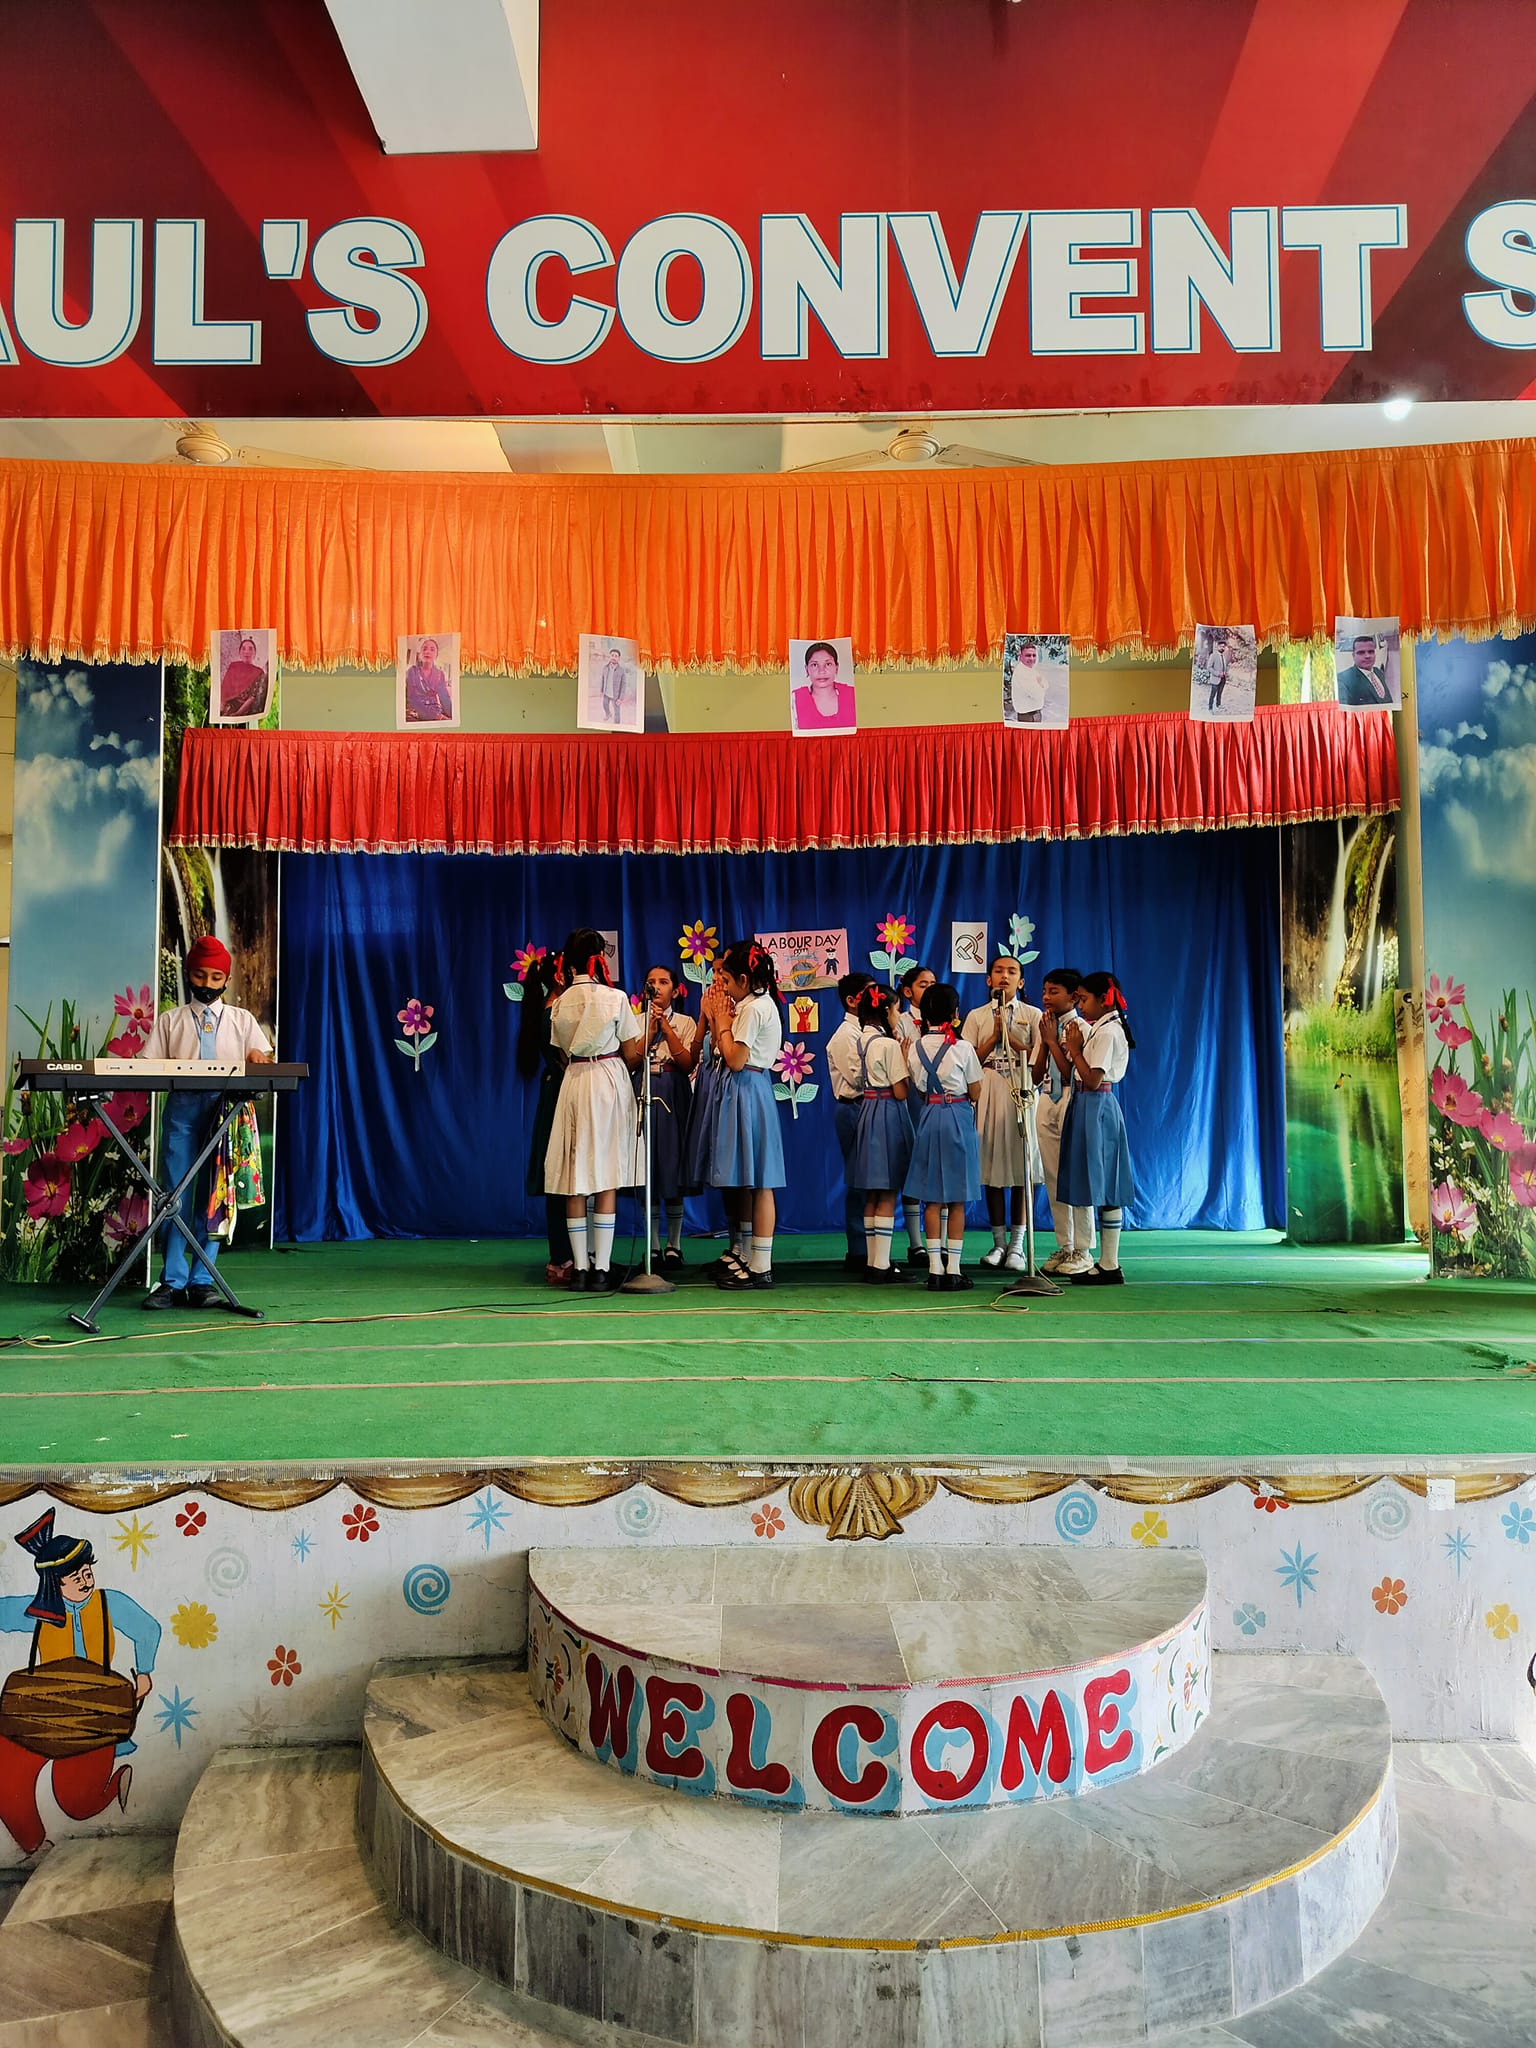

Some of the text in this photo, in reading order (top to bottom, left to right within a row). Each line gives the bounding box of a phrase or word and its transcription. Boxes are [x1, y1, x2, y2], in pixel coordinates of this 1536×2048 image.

[0, 216, 429, 367] UL'S
[486, 204, 1408, 366] CONVENT
[815, 934, 841, 948] DAY
[46, 1063, 83, 1071] CASIO
[584, 1652, 1134, 1804] WELCOME
